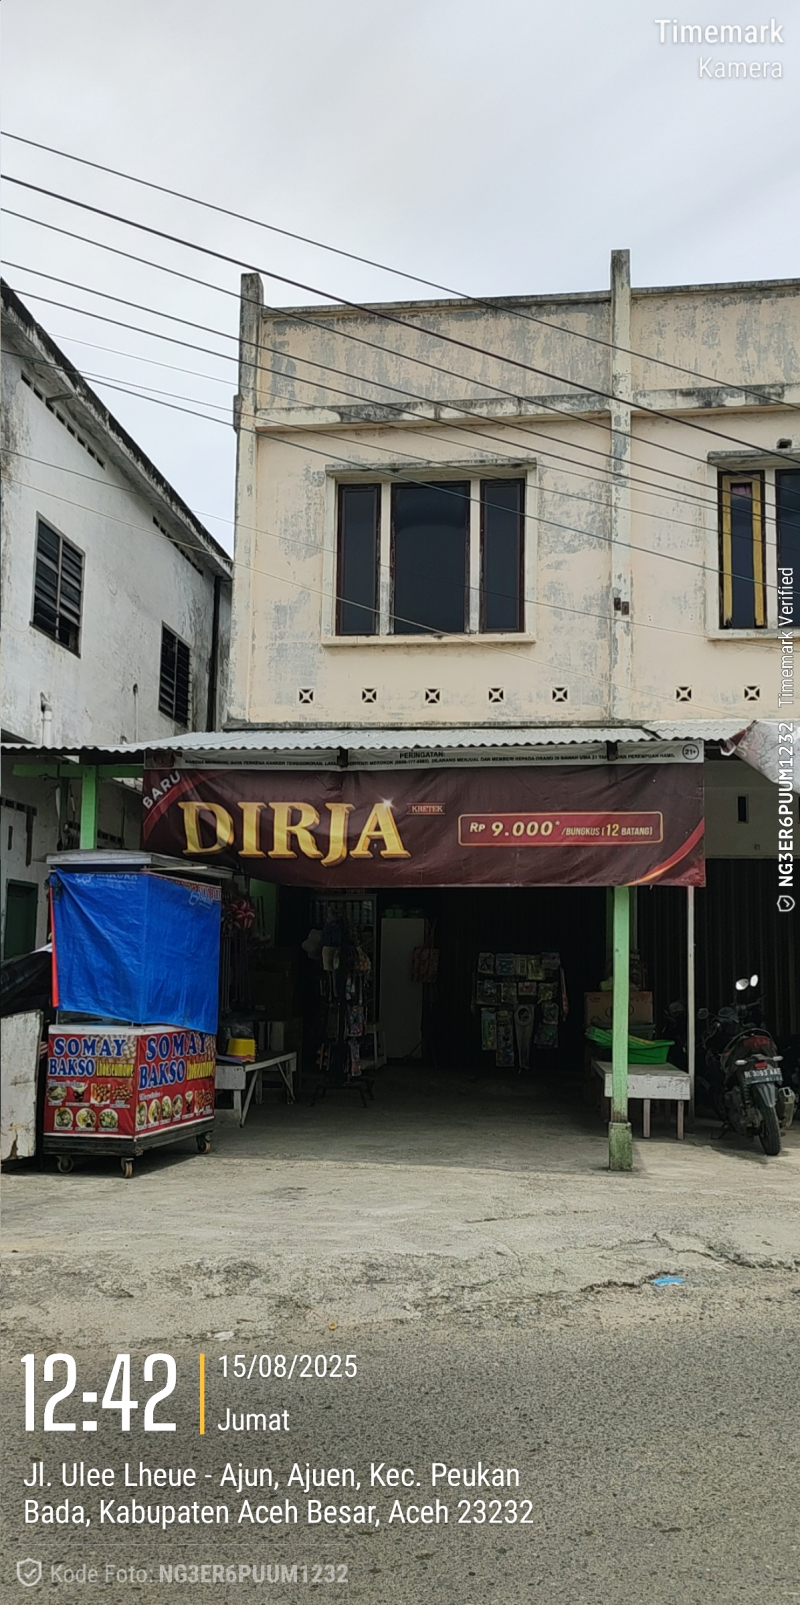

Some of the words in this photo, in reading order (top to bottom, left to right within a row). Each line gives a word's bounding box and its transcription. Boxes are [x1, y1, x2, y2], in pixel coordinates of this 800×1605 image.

[400, 751, 445, 759] PERINGATAN:
[143, 770, 181, 809] BARU
[411, 805, 443, 813] KRETEK
[177, 801, 411, 868] DIRJA
[53, 1037, 127, 1057] SOMAY
[145, 1031, 207, 1062] SOMAY
[48, 1057, 96, 1077] BAKSO
[138, 1059, 186, 1090] BAKSO
